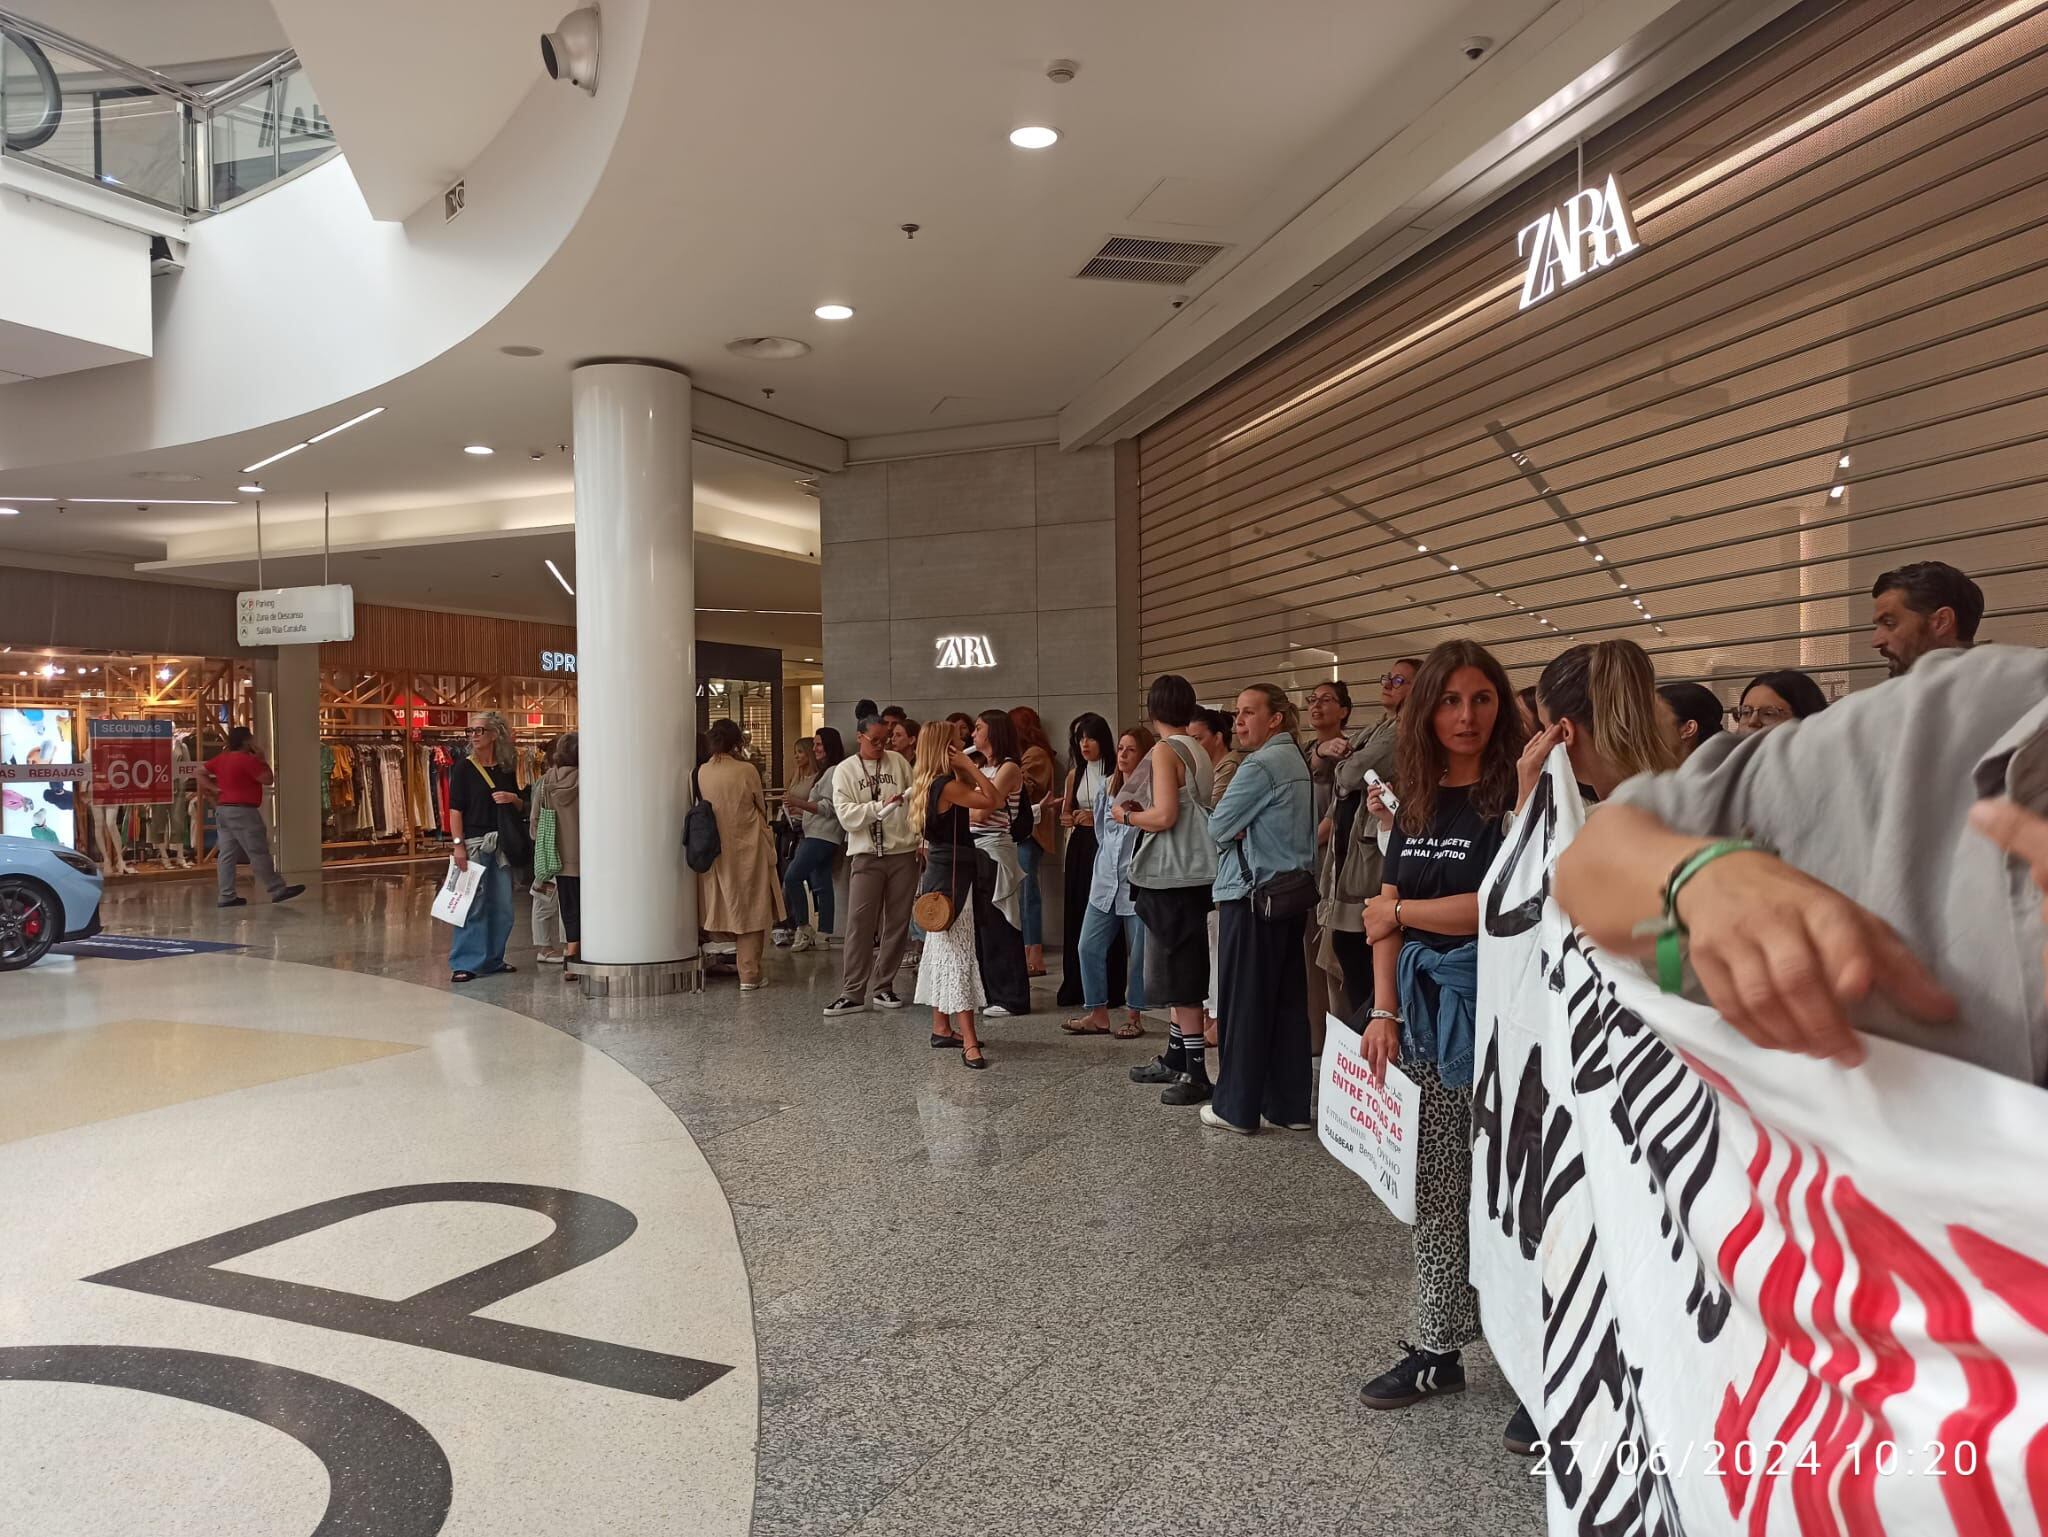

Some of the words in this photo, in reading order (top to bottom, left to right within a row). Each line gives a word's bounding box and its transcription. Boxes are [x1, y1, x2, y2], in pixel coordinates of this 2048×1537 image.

[1517, 173, 1640, 311] ZARA
[255, 599, 275, 609] Parking
[936, 634, 997, 669] ZARA
[101, 723, 162, 734] SEGUNDAS
[28, 768, 85, 778] REBAJAS
[95, 759, 169, 790] -60%
[1332, 1070, 1363, 1102] ENTRE
[1390, 1121, 1404, 1142] AS
